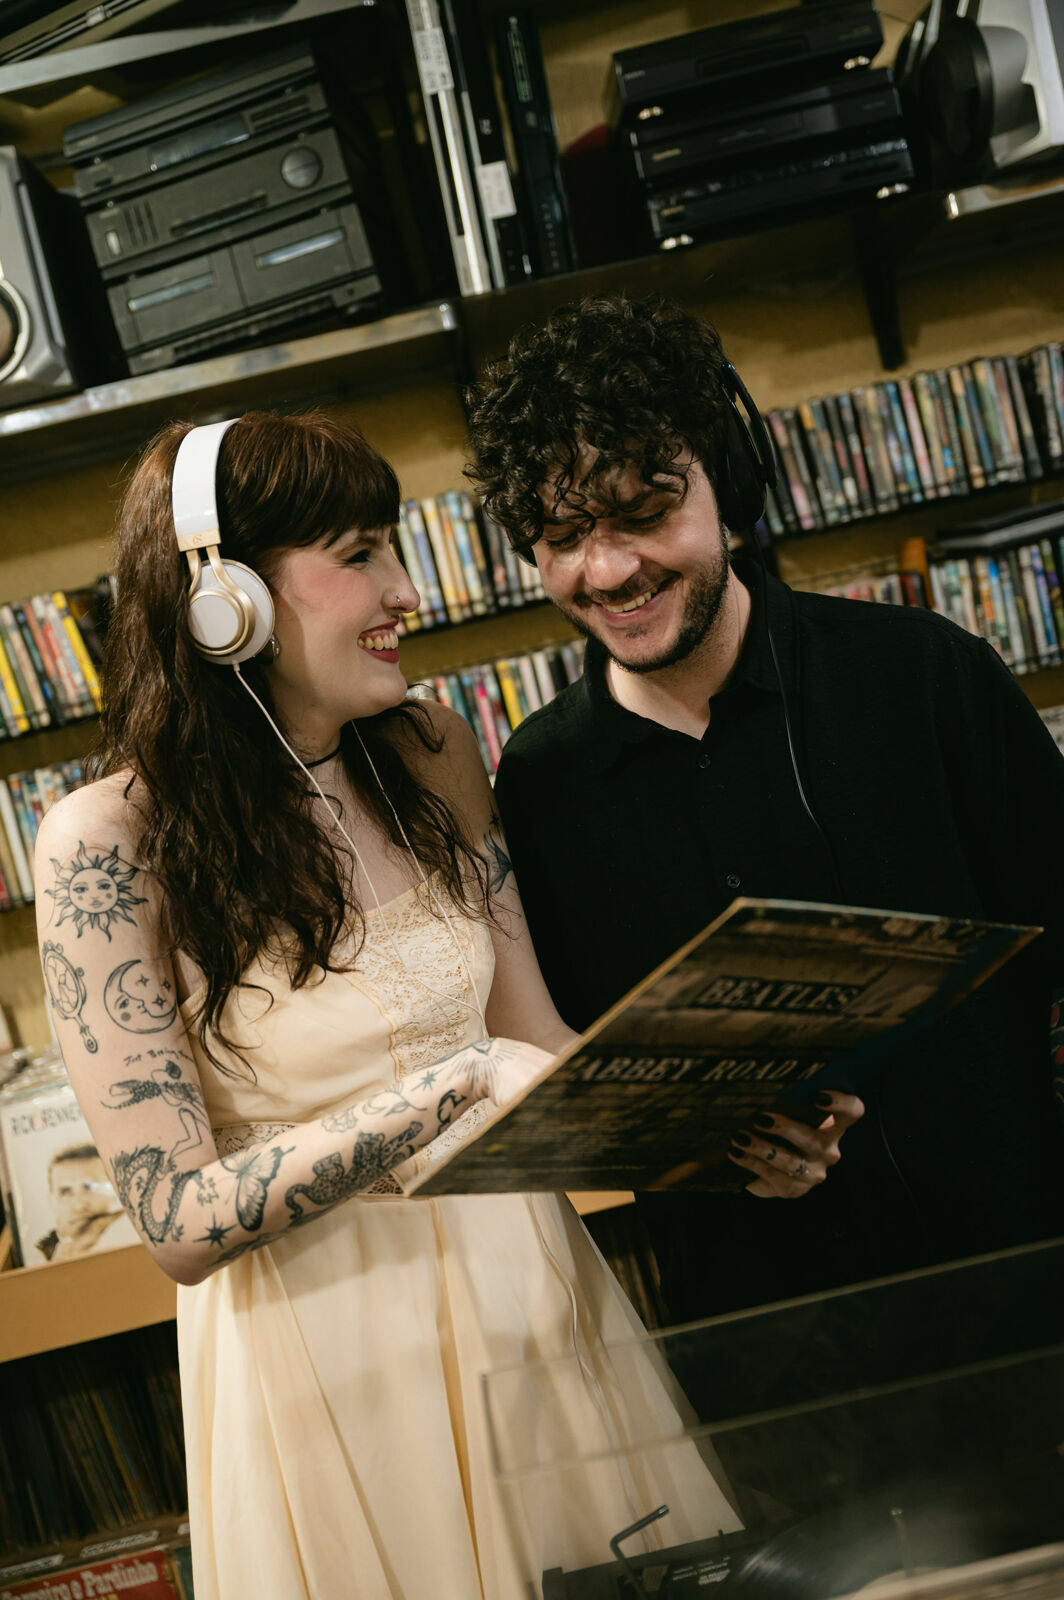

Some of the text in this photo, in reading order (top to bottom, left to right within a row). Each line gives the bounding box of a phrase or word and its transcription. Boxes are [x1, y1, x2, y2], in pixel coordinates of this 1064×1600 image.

[698, 978, 859, 1011] BEATLES
[575, 1056, 704, 1081] ABBEY
[702, 1058, 798, 1081] ROAD
